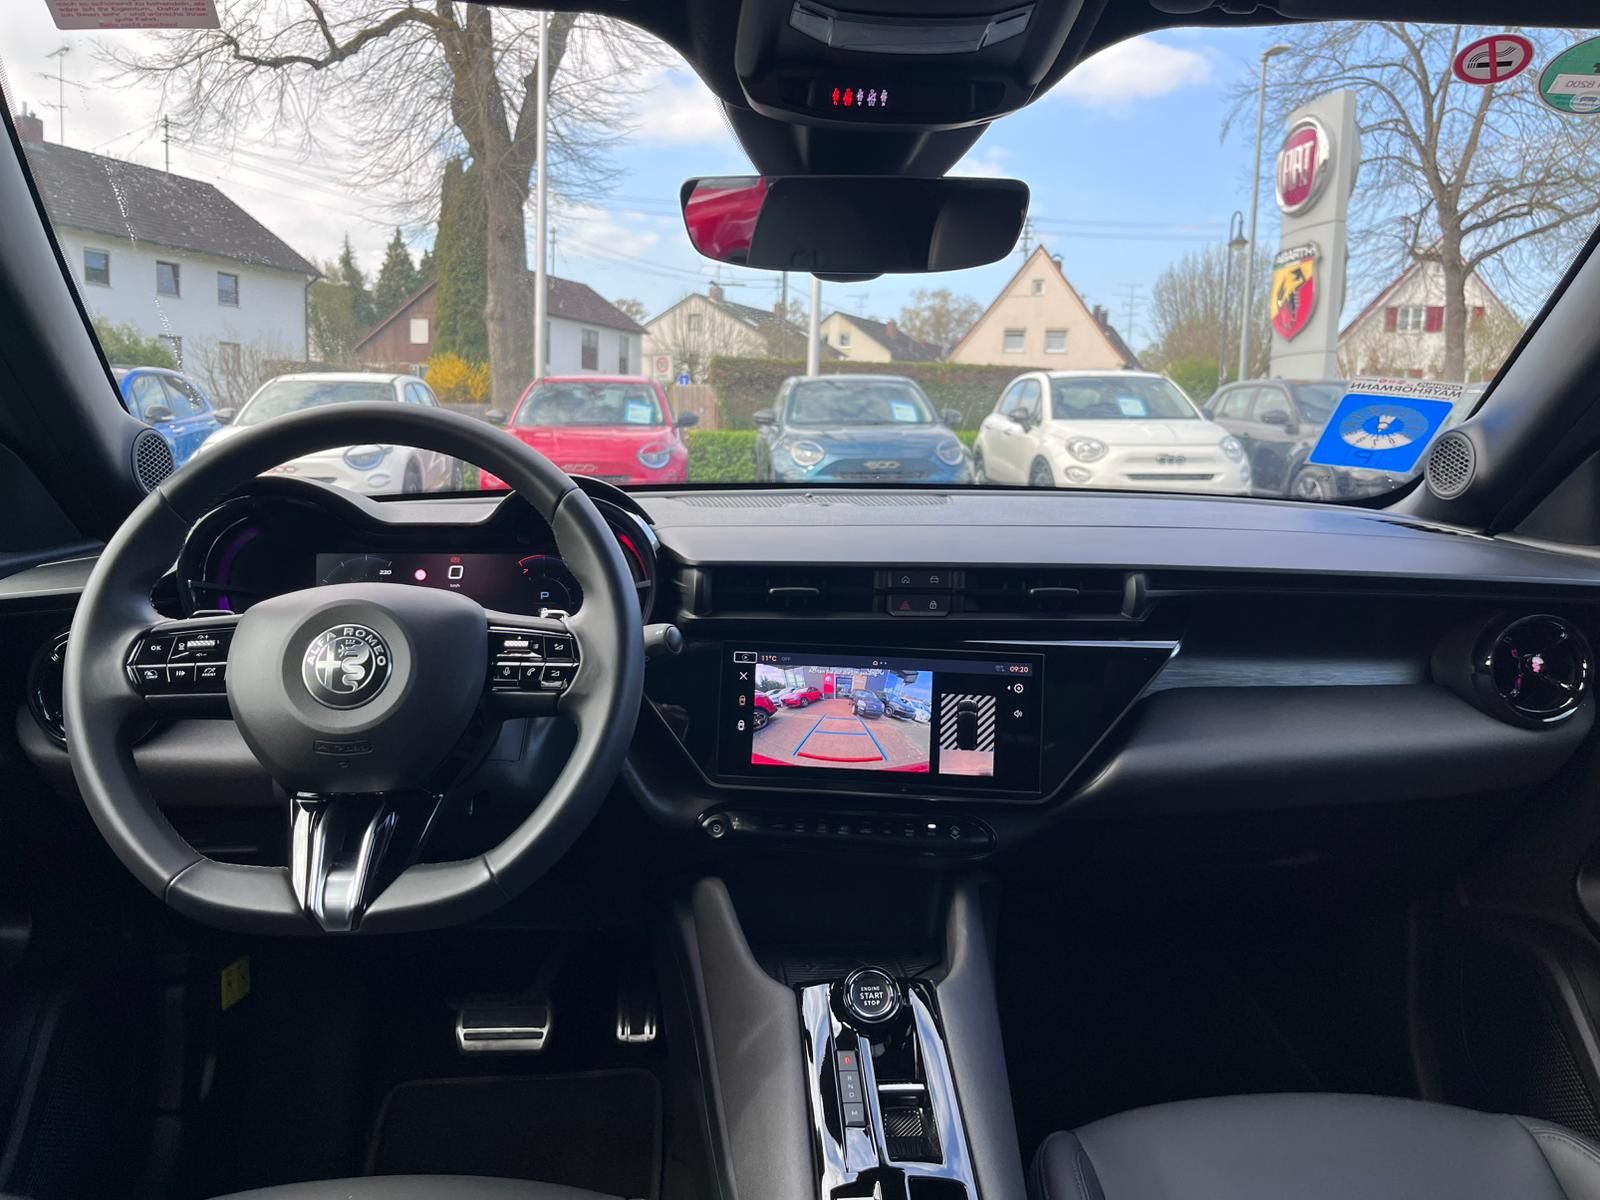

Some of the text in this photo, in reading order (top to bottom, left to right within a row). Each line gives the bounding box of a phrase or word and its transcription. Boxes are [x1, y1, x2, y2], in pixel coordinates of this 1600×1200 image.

[540, 591, 550, 600] P
[307, 627, 387, 667] ALFA ROMEO
[1009, 665, 1029, 673] 09:20
[860, 991, 883, 1000] START
